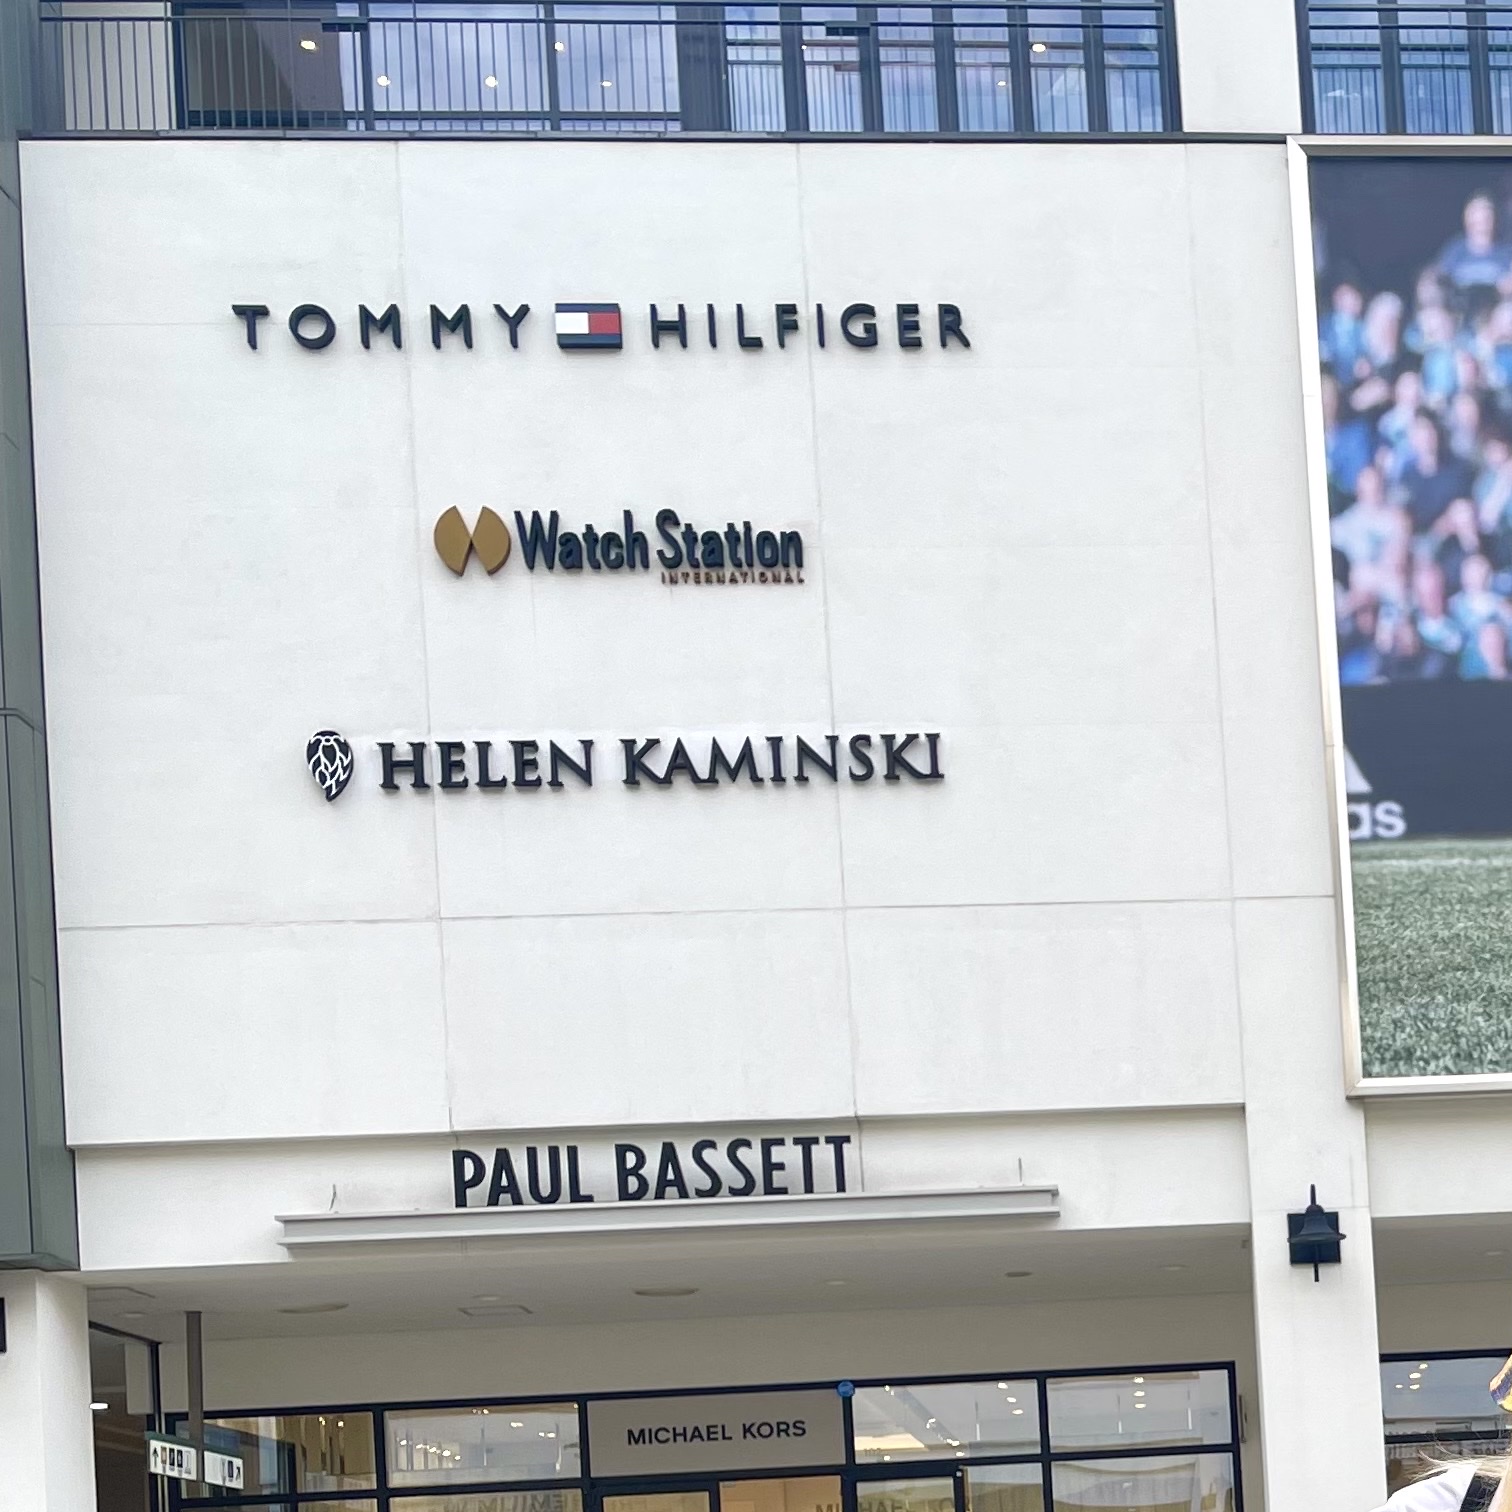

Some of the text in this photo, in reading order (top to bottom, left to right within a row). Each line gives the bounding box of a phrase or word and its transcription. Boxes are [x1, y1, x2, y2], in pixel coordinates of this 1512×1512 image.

[232, 302, 972, 351] TOMMY HILFIGER
[514, 508, 804, 571] Watch Station
[661, 570, 806, 585] INTERNATIONAL
[376, 732, 944, 791] HELEN KAMINSKI
[452, 1135, 852, 1208] PAUL BASSETT
[627, 1420, 807, 1446] MICHAEL KORS
